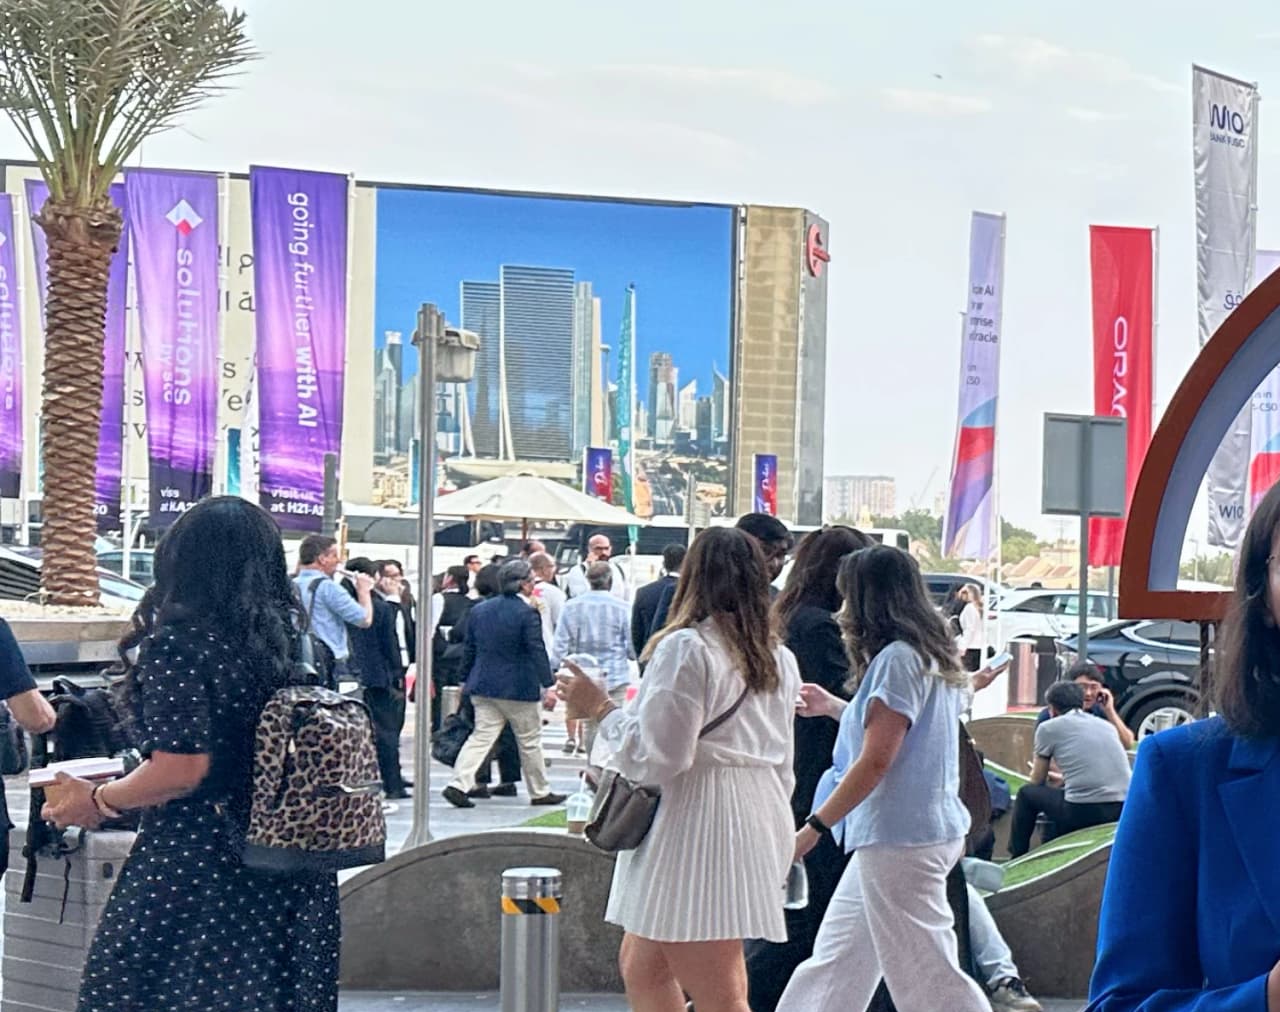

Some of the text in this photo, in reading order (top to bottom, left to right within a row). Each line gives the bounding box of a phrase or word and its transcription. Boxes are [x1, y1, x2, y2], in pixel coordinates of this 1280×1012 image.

[288, 192, 309, 254] going
[177, 248, 201, 406] solutions
[298, 345, 319, 404] with
[298, 406, 318, 428] AI
